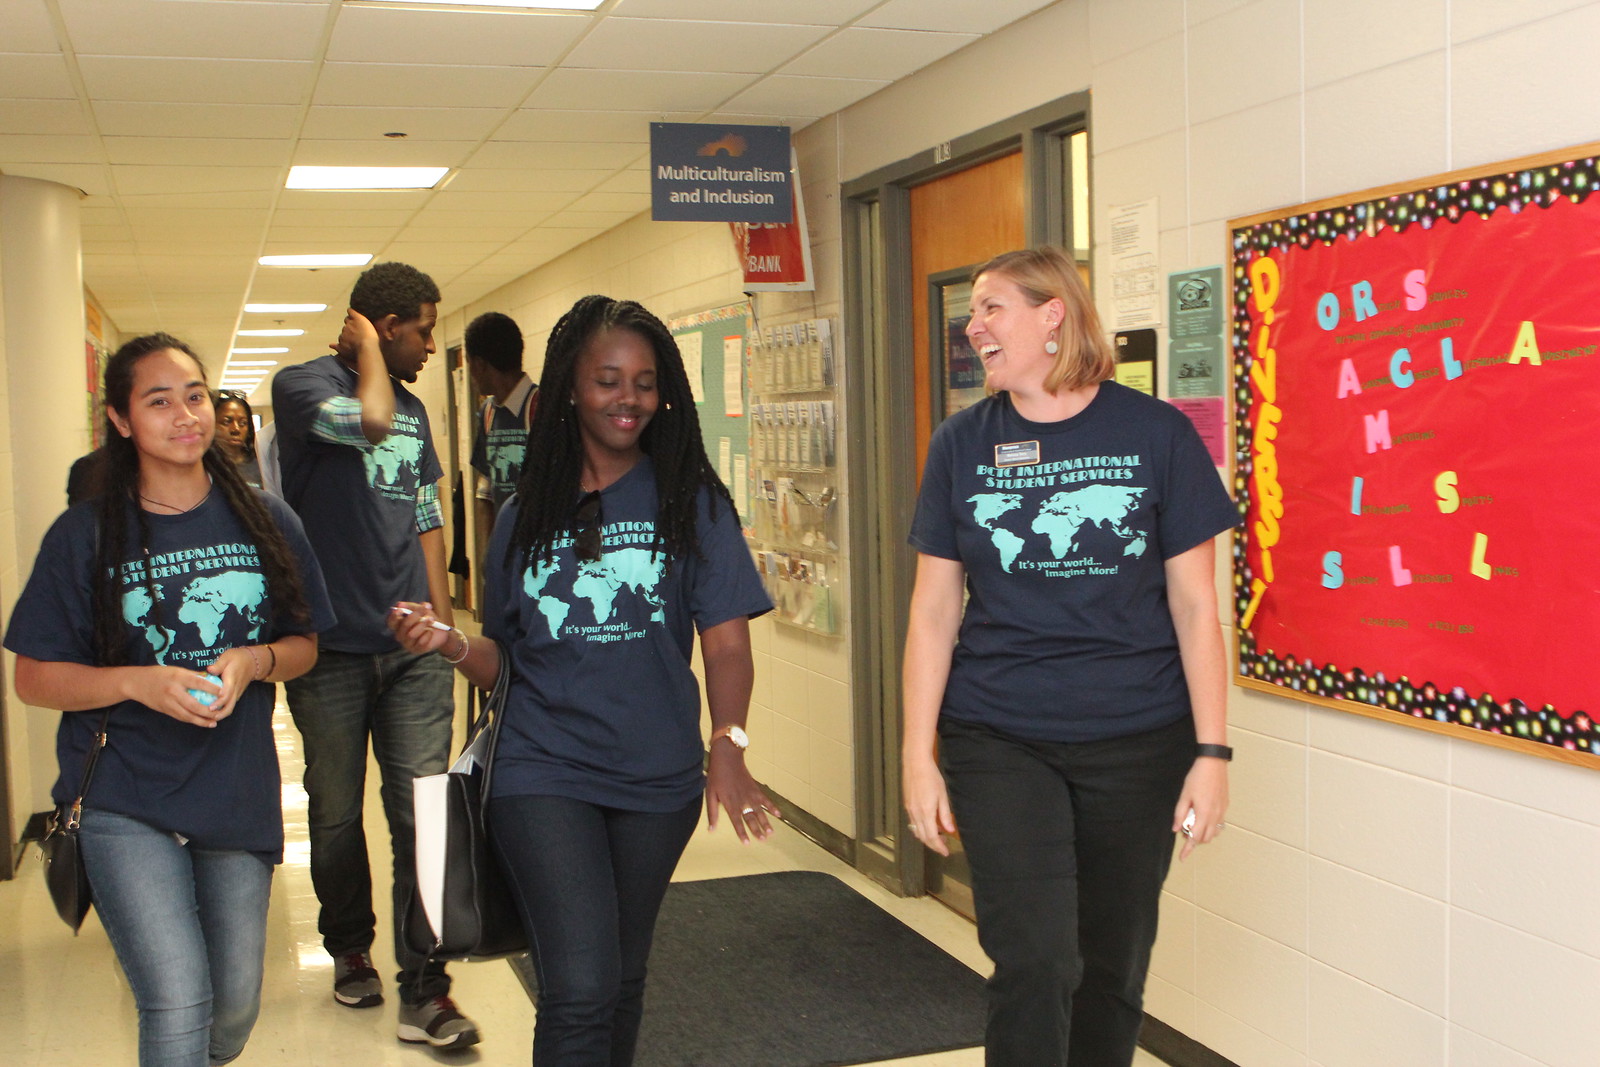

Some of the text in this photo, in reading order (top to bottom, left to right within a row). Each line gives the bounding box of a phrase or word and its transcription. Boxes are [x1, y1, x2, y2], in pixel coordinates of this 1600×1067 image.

[657, 165, 785, 183] Multiculturalism
[669, 188, 774, 204] and Inclusion
[749, 255, 782, 273] BANK
[976, 455, 1141, 478] BCTC INTERNATIONAL
[985, 468, 1134, 490] STUDENT SERVICES
[150, 543, 258, 566] INTERNATIONA
[195, 555, 261, 572] SERVICES
[1018, 560, 1035, 570] It's
[1037, 561, 1061, 571] your
[1045, 564, 1119, 579] Imagine More!
[565, 625, 580, 634] It's
[581, 626, 602, 636] your
[172, 651, 187, 661] It's
[189, 648, 210, 661] your
